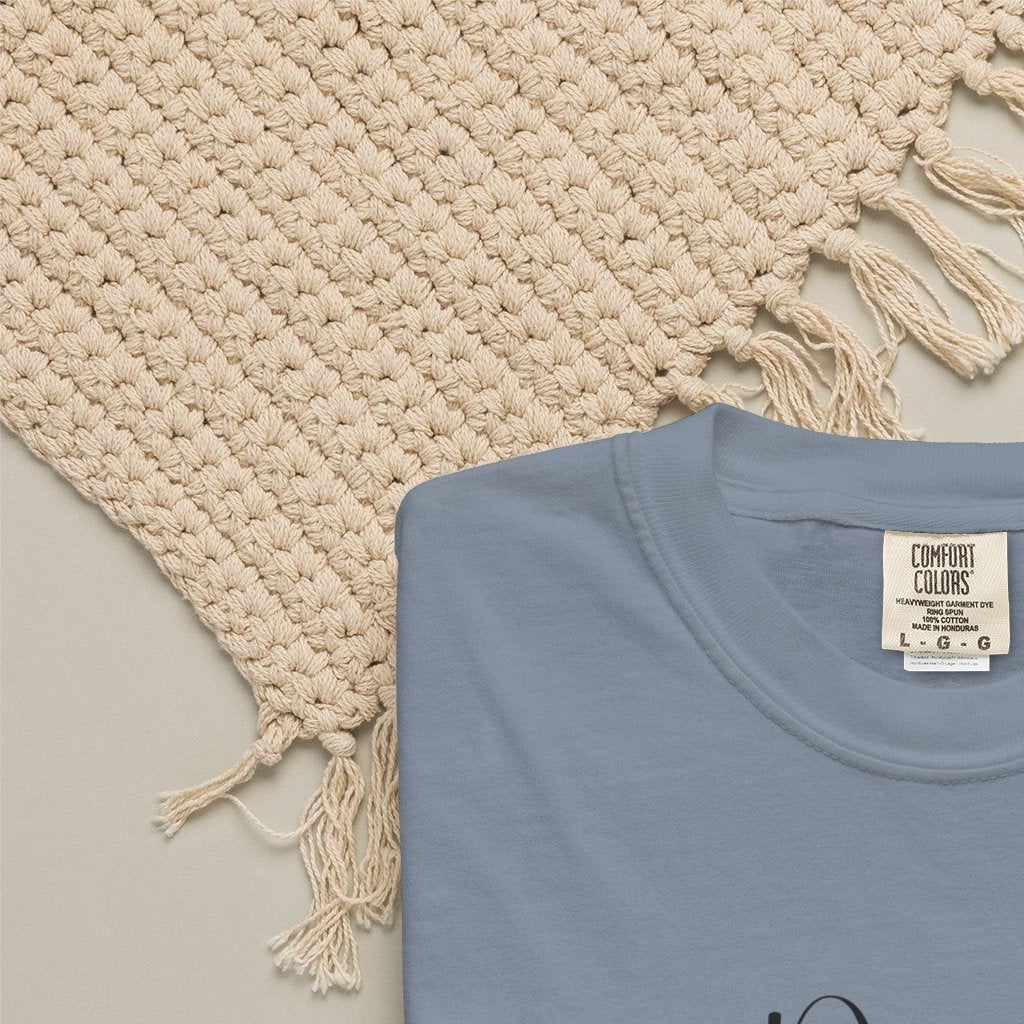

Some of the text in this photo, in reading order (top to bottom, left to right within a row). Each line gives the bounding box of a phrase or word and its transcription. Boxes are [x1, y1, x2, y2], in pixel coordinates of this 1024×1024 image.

[911, 543, 975, 568] COMFORT
[895, 598, 994, 609] HEAVYWEIGHT GARMENT DYE
[926, 608, 943, 616] RING
[922, 616, 969, 624] 100% COTTON
[911, 623, 979, 632] MADE IN HONDURAS
[899, 632, 911, 648] L
[936, 635, 951, 650] G
[977, 635, 991, 651] G
